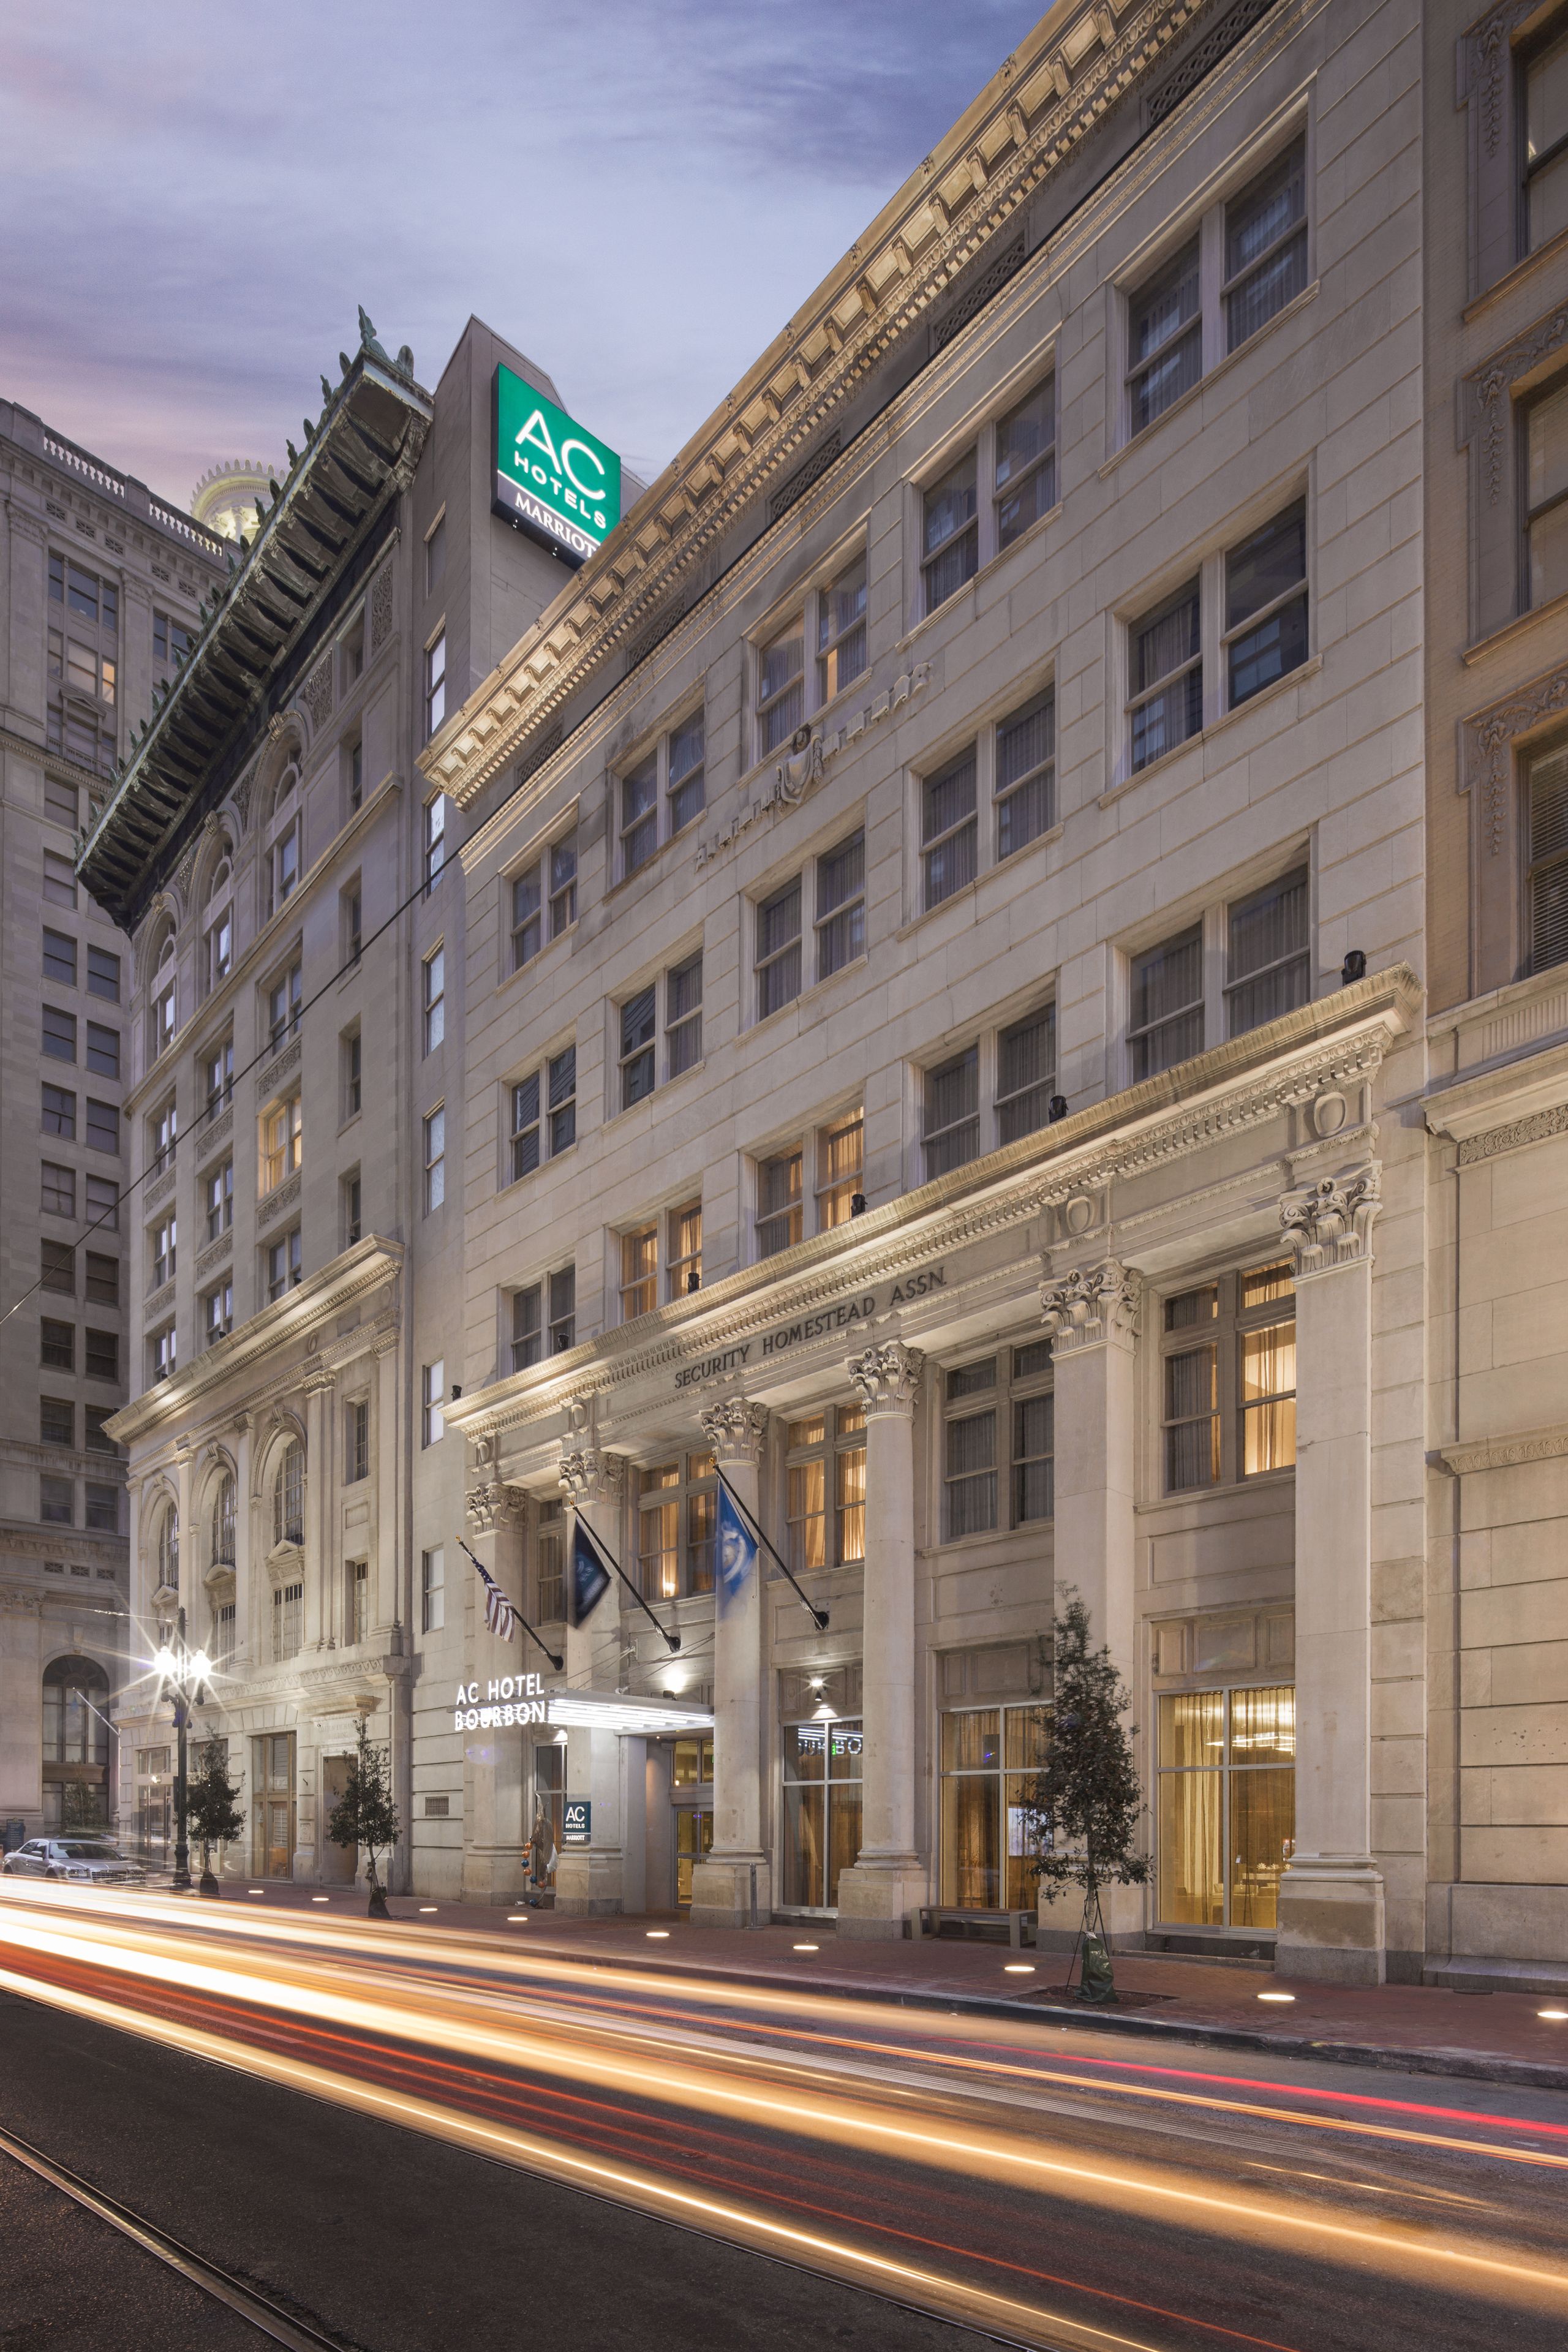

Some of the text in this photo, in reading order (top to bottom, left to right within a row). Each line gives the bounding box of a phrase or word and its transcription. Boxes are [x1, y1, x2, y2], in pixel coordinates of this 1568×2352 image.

[515, 409, 606, 500] AC
[514, 451, 606, 529] HOTELS
[515, 492, 597, 558] MARRIOT
[674, 1267, 948, 1389] SECURITY HOMESTEAD ASSN.
[454, 1700, 546, 1731] BOURBON
[456, 1673, 545, 1705] AC HOTEL
[565, 1806, 585, 1822] AC
